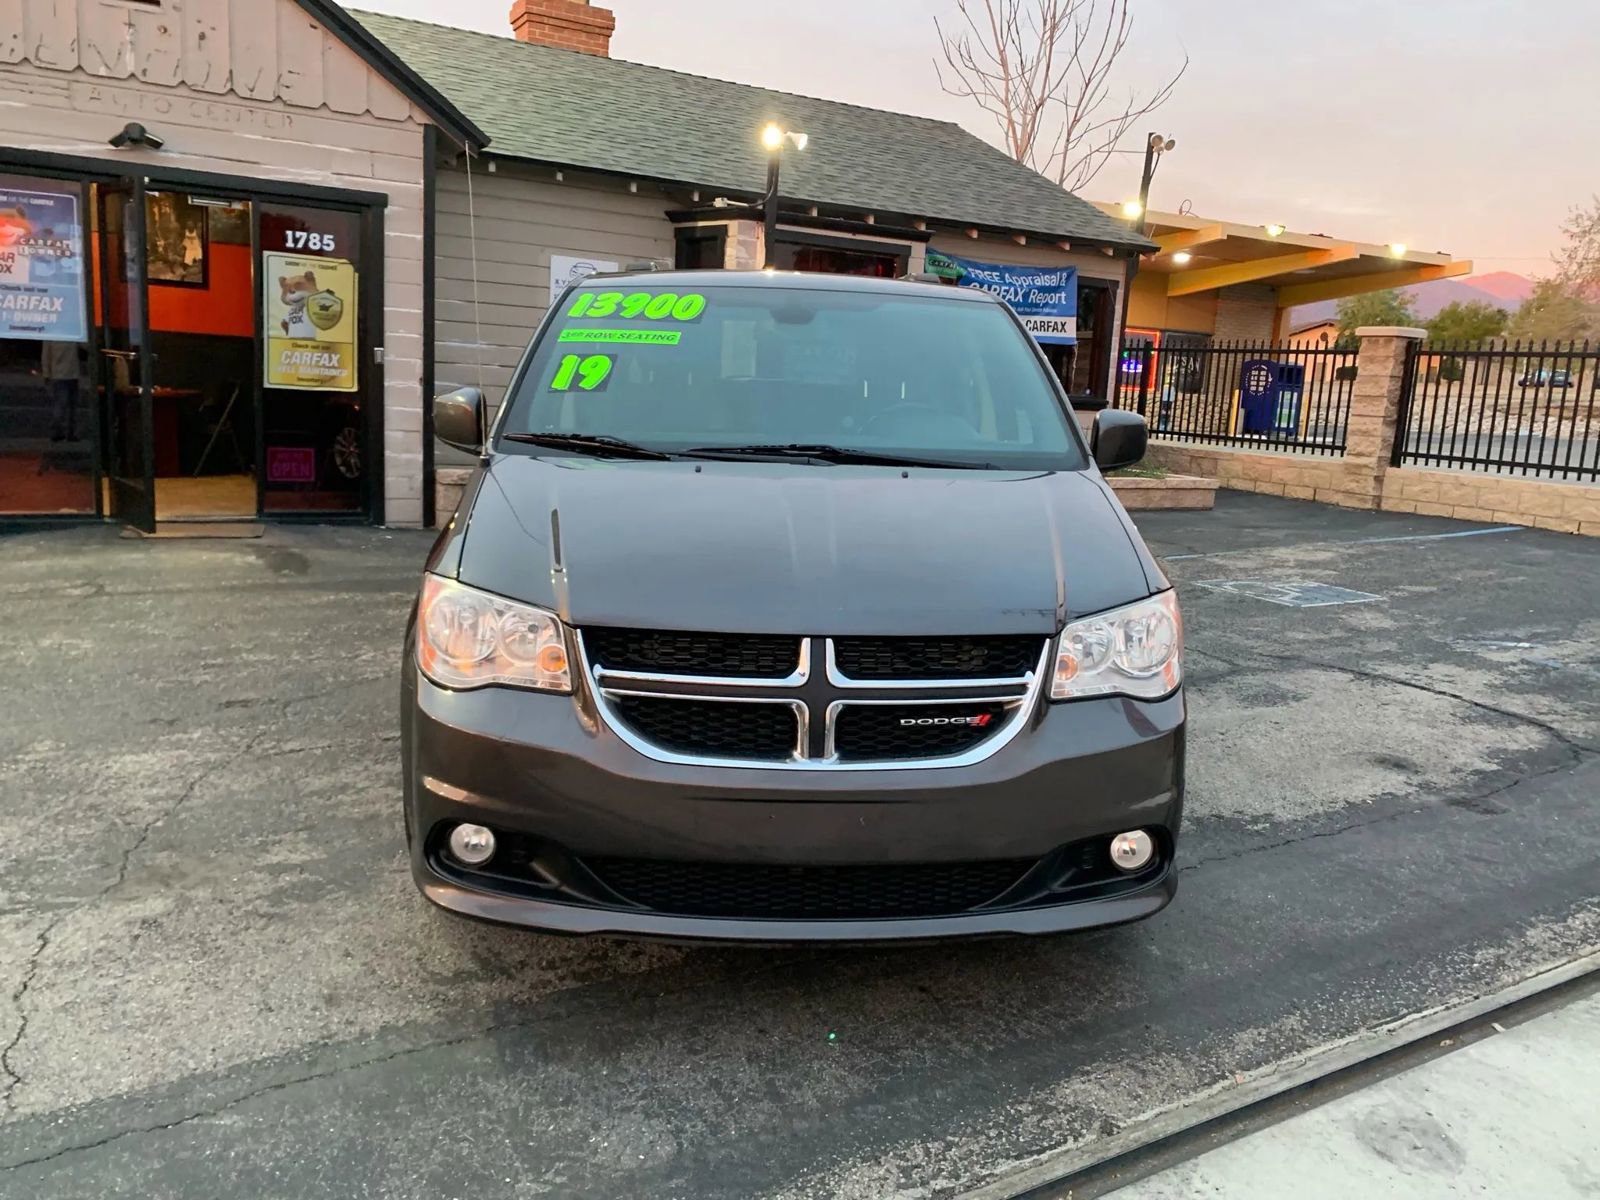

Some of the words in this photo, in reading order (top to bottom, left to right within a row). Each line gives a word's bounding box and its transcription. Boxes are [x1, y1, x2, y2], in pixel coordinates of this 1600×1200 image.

[284, 229, 336, 252] 1785
[0, 251, 15, 264] AR
[0, 264, 13, 275] OX
[967, 266, 1004, 285] FREE
[1004, 270, 1060, 289] Appraisal
[1060, 272, 1067, 287] &
[568, 291, 706, 321] 13900
[1028, 289, 1067, 307] Report
[1025, 319, 1067, 334] CARFAX
[584, 331, 615, 340] ROW
[616, 332, 678, 342] SEATING
[280, 350, 341, 368] CARFAX
[551, 354, 613, 390] 19
[271, 462, 310, 477] OPEN
[899, 716, 980, 727] DODGE
